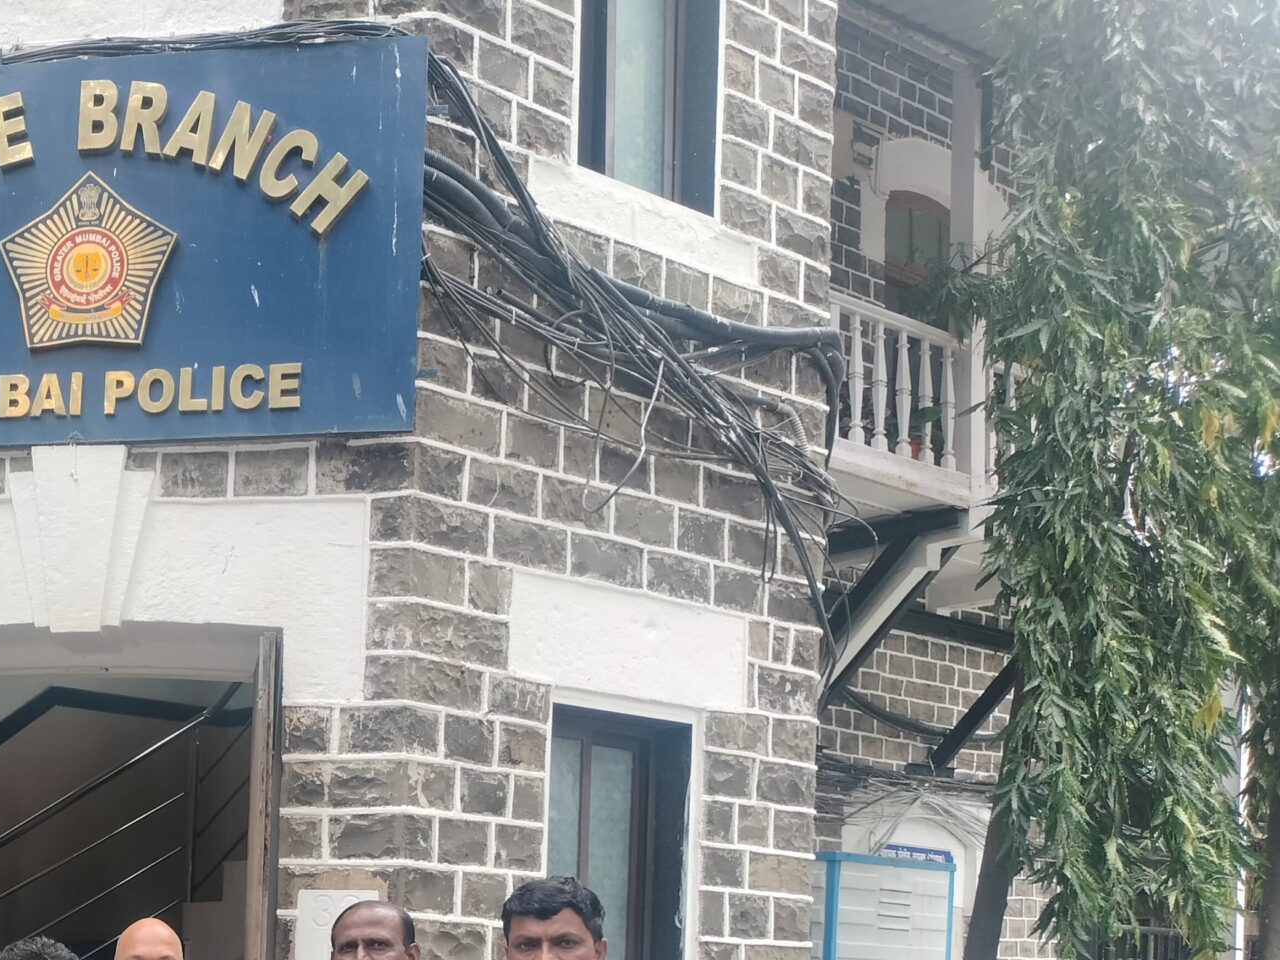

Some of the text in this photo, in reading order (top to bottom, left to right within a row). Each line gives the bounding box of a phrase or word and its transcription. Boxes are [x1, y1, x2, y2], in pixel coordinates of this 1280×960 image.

[77, 80, 370, 234] BRANCH
[53, 233, 119, 281] GREATER MUMBAI POLICE
[104, 363, 302, 416] POLICE
